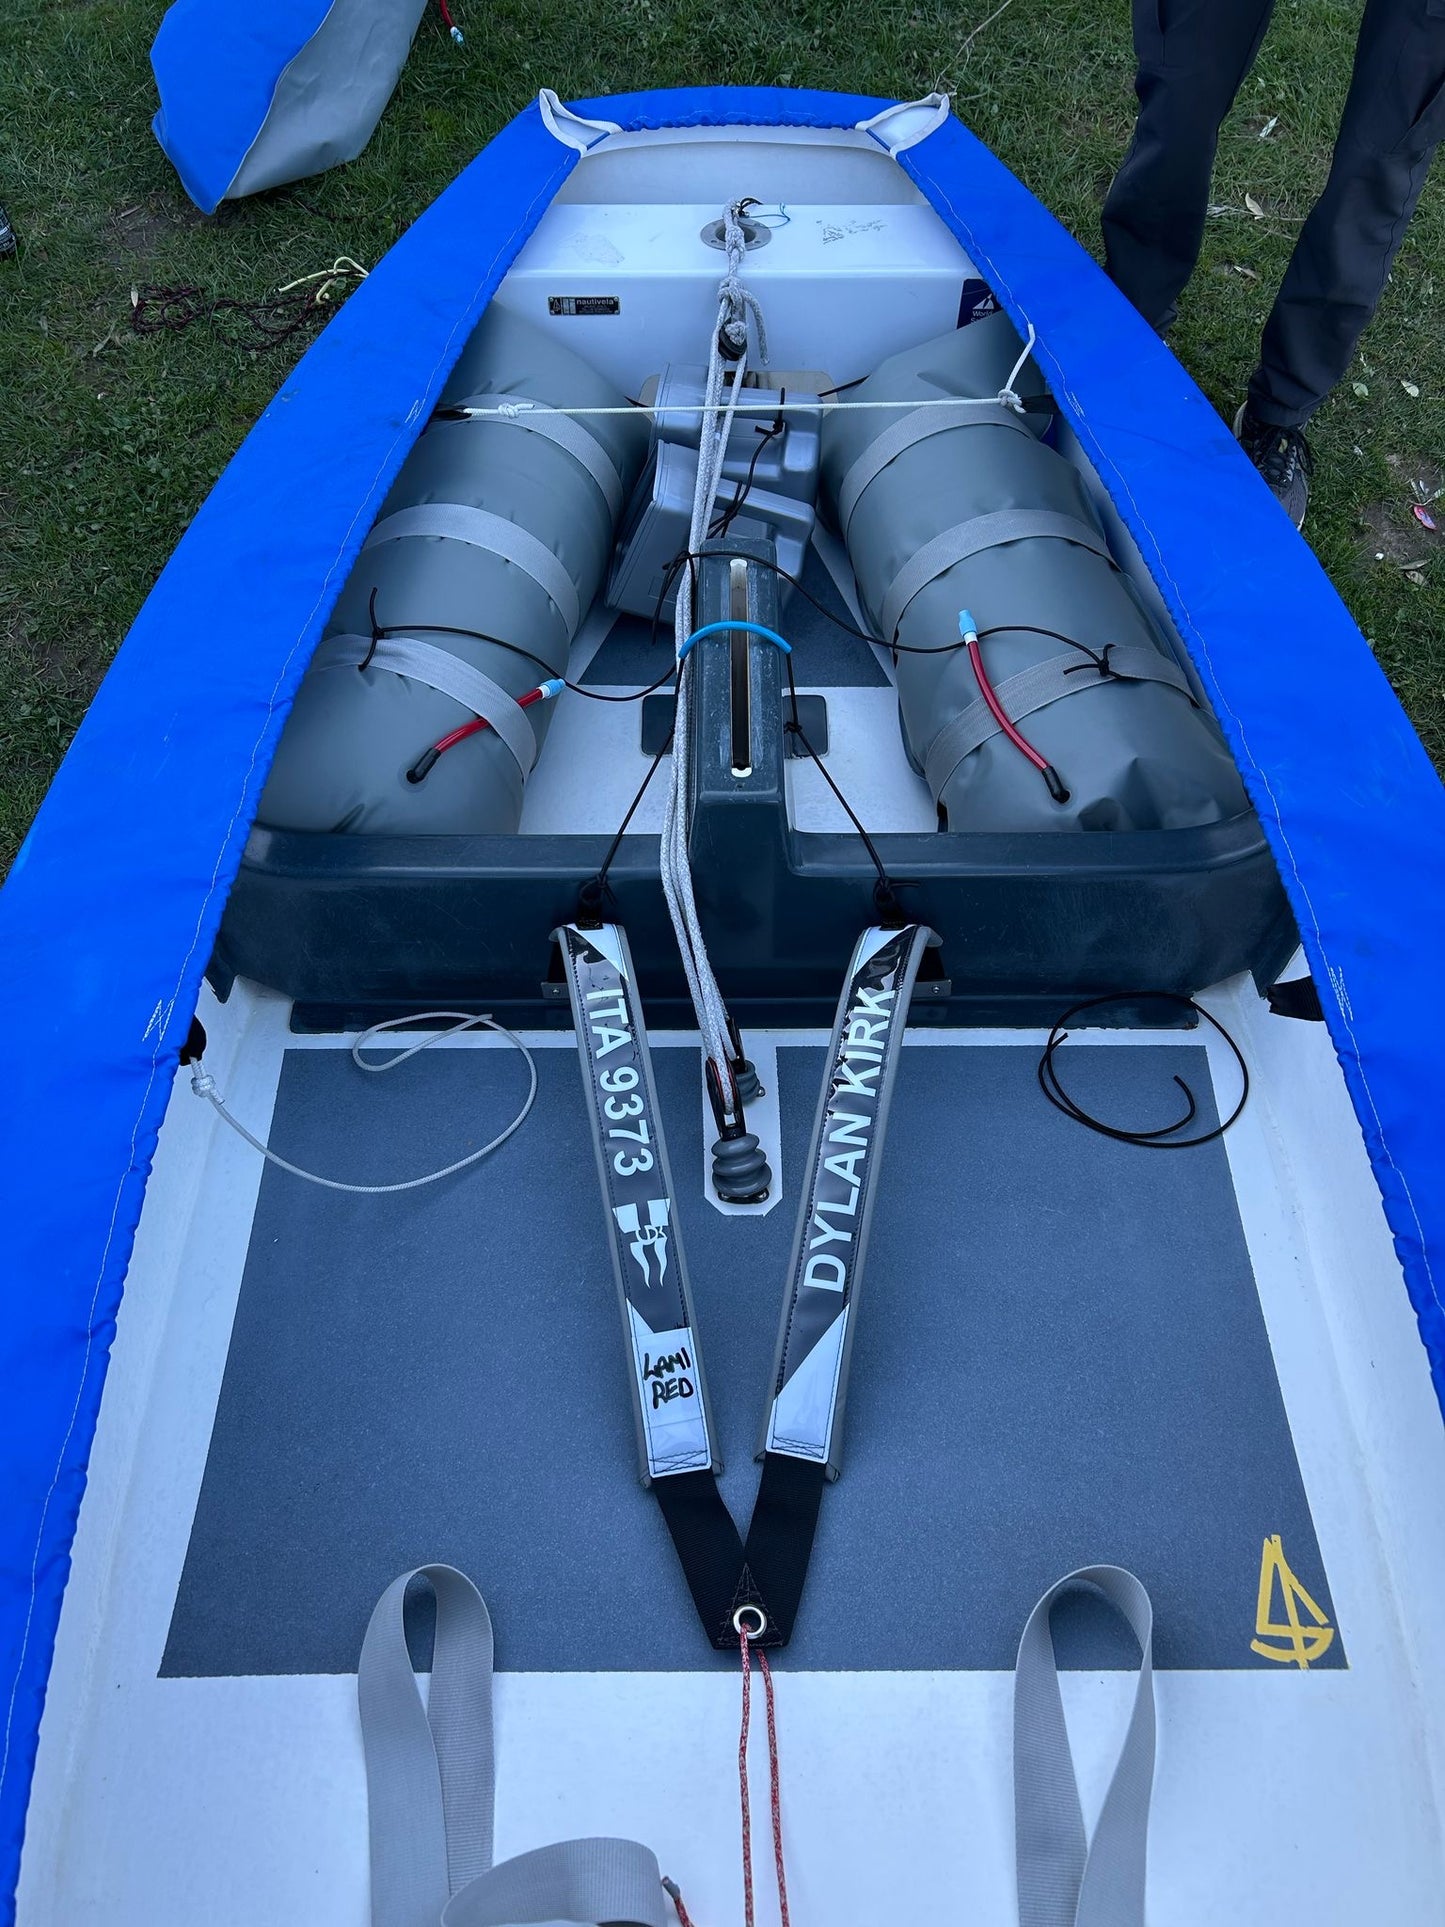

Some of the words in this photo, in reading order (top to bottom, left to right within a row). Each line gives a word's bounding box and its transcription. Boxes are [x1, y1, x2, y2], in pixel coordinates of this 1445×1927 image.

[586, 988, 632, 1059] ITA
[837, 986, 896, 1097] KIRK
[599, 1066, 654, 1177] 9373
[803, 1111, 872, 1293] DYLAN
[652, 1377, 694, 1409] RED
